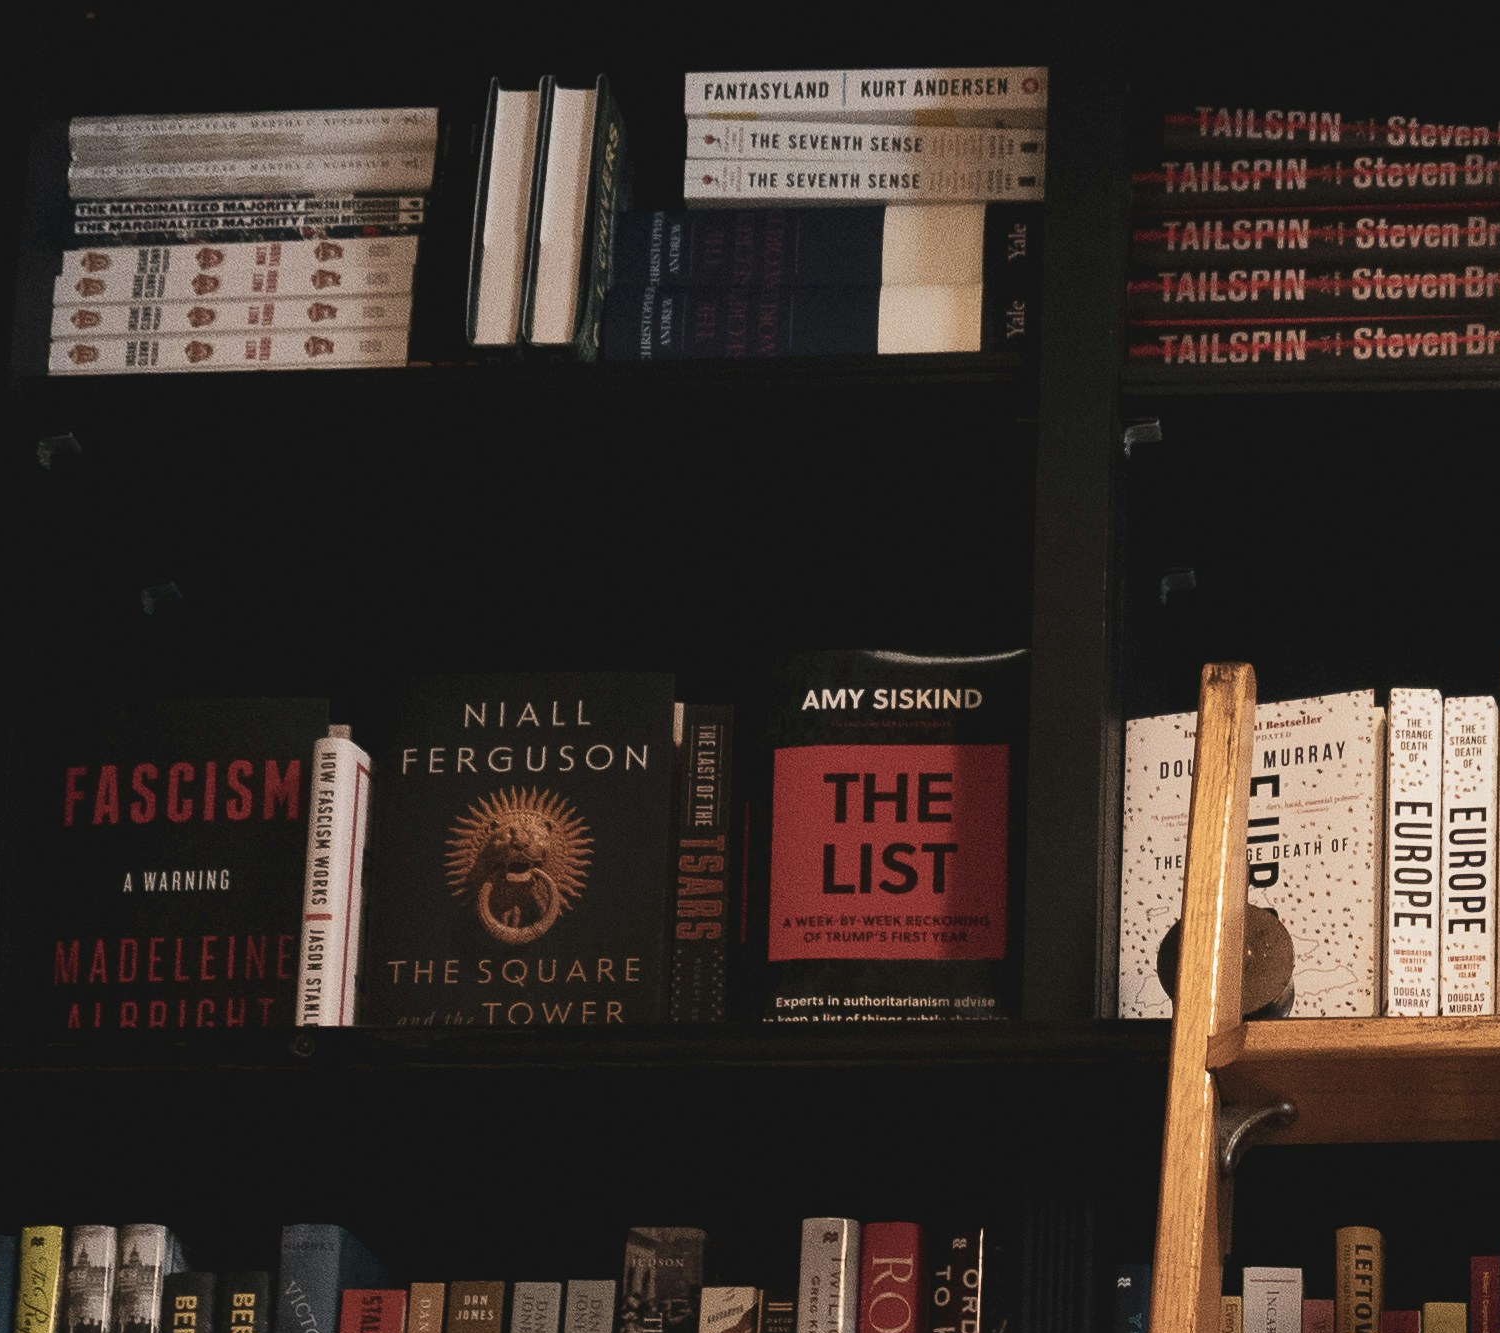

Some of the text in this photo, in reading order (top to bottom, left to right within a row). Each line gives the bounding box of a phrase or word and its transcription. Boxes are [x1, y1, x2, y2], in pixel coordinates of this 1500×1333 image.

[703, 78, 1009, 101] FANTASYLAND KURT ANDERSEN
[750, 133, 923, 153] THE SEVENTH SENSE
[1162, 218, 1309, 252] TAILSPIN
[1353, 217, 1461, 251] Steven
[463, 699, 592, 730] NIALL
[802, 687, 984, 712] AMY SISKIND
[401, 744, 650, 776] FERGUSON
[62, 758, 300, 827] FASCISM
[823, 772, 953, 823] THE
[122, 868, 230, 892] A WARNING
[822, 842, 956, 895] LIST
[1394, 801, 1434, 931] EUROPE
[387, 956, 643, 988] THE SQUARE
